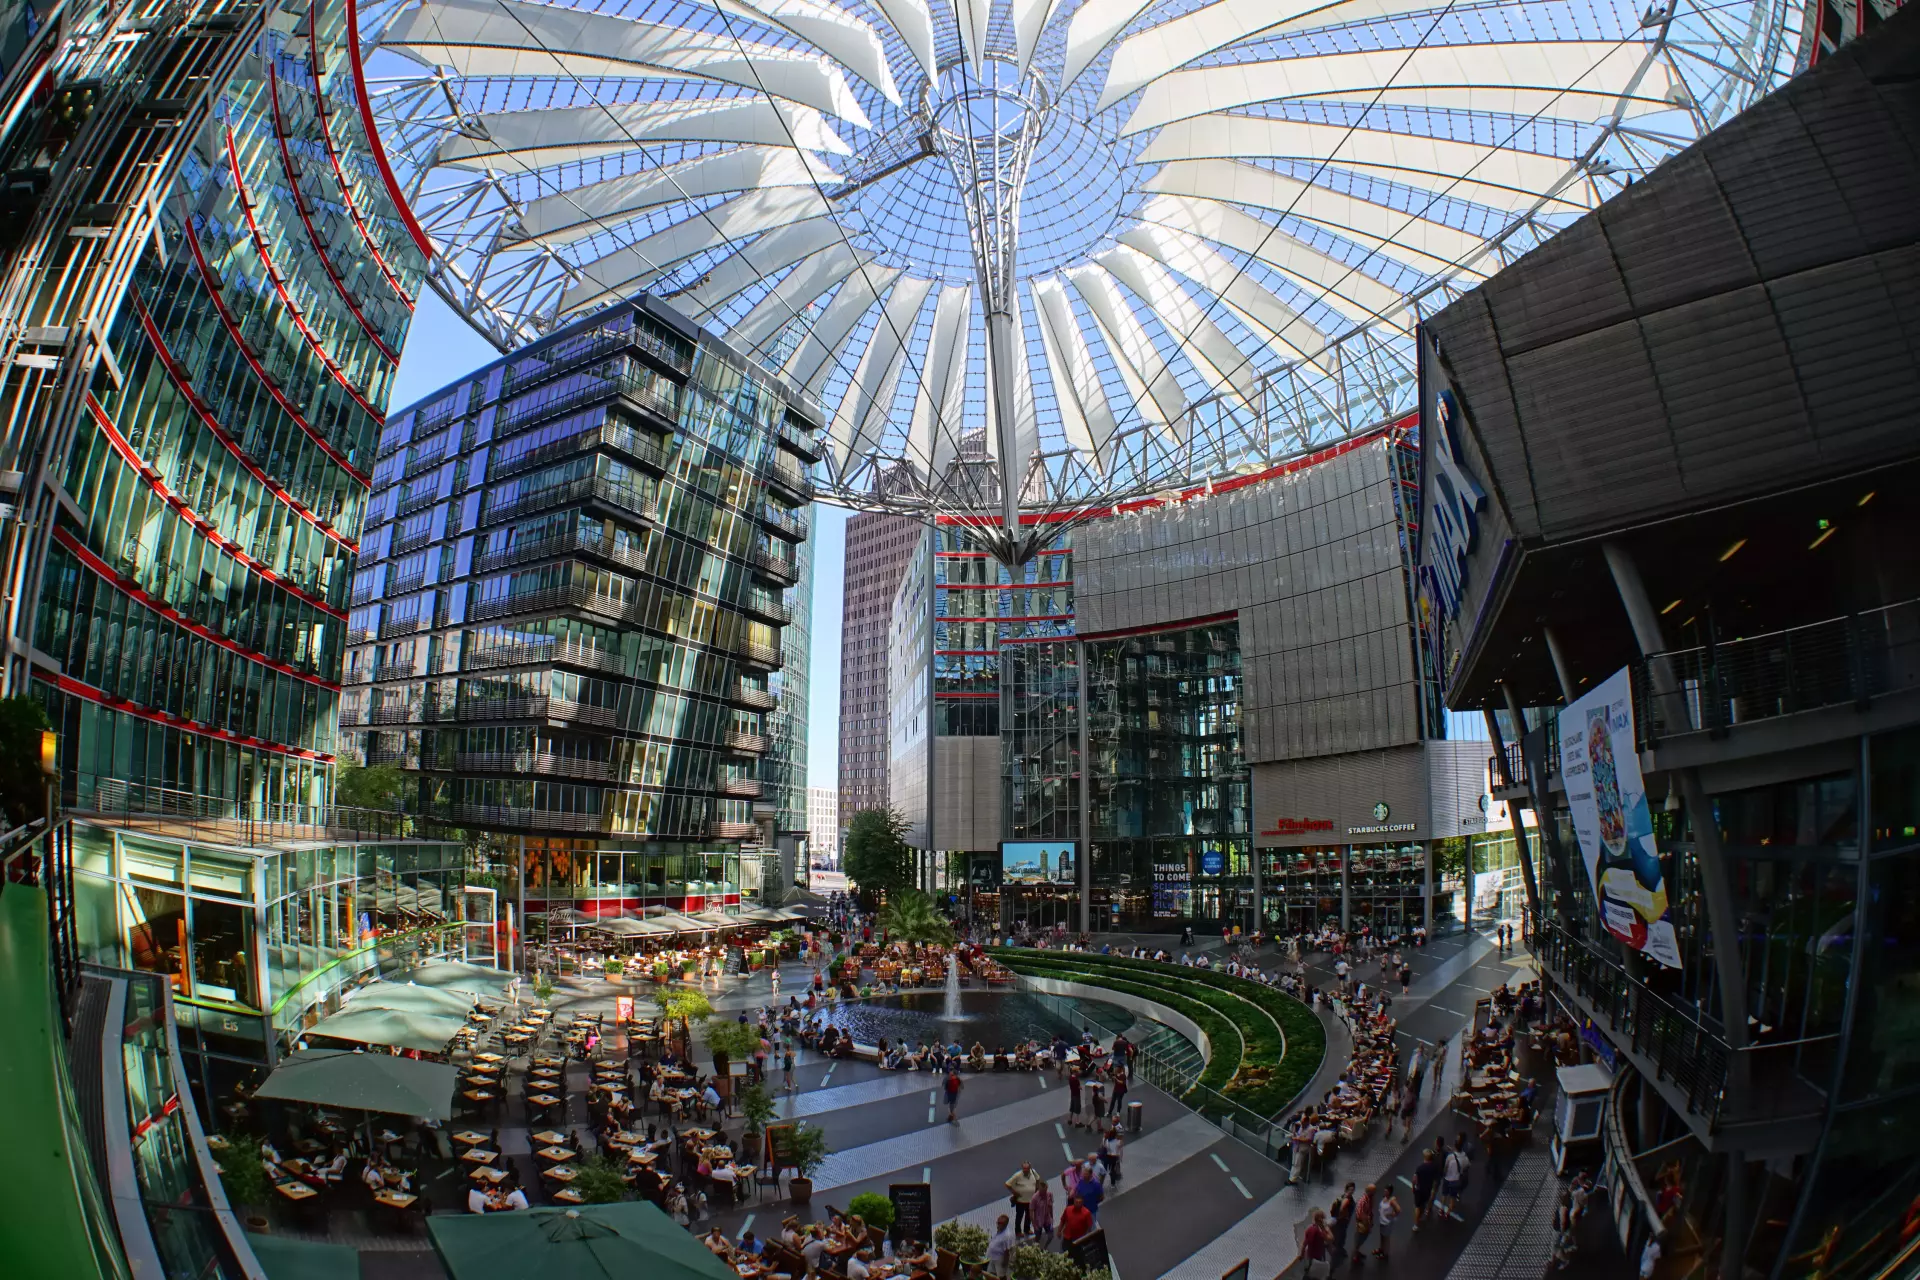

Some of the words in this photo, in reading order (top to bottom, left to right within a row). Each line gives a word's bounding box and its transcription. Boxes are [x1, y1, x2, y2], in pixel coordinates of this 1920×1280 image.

[1278, 817, 1333, 831] Filmhaus
[1348, 825, 1388, 834] STARBUCKS
[1389, 823, 1416, 832] COFFEE
[1153, 863, 1186, 872] THINGS
[1153, 873, 1165, 881] TO
[1167, 873, 1191, 881] COME
